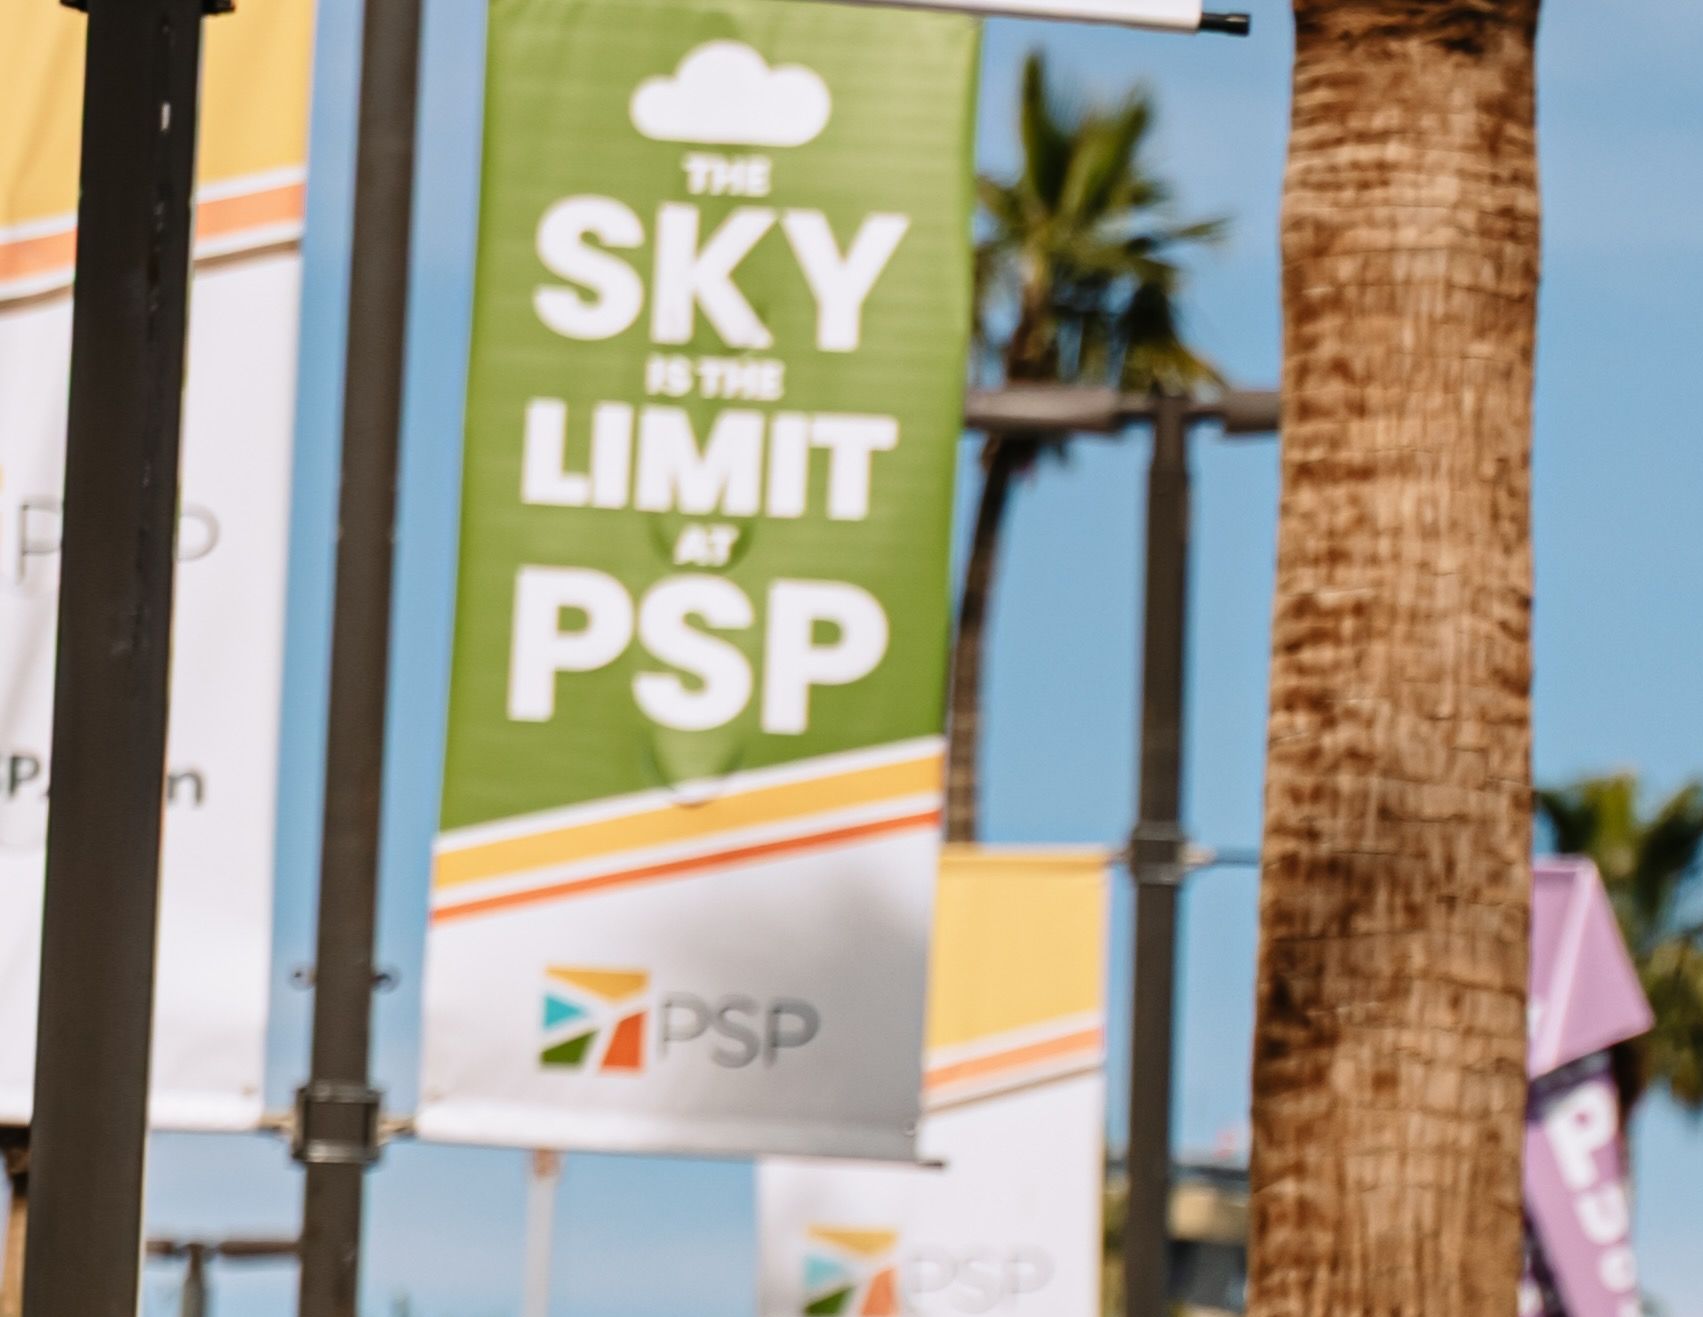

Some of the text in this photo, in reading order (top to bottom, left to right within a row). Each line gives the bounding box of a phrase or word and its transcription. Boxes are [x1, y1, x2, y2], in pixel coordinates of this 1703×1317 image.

[684, 153, 772, 198] THE
[531, 195, 910, 353] SKY
[647, 356, 784, 401] IS THE
[520, 399, 900, 521] LIMIT
[673, 524, 734, 568] AT
[506, 565, 891, 734] PSP
[658, 991, 822, 1069] PSP
